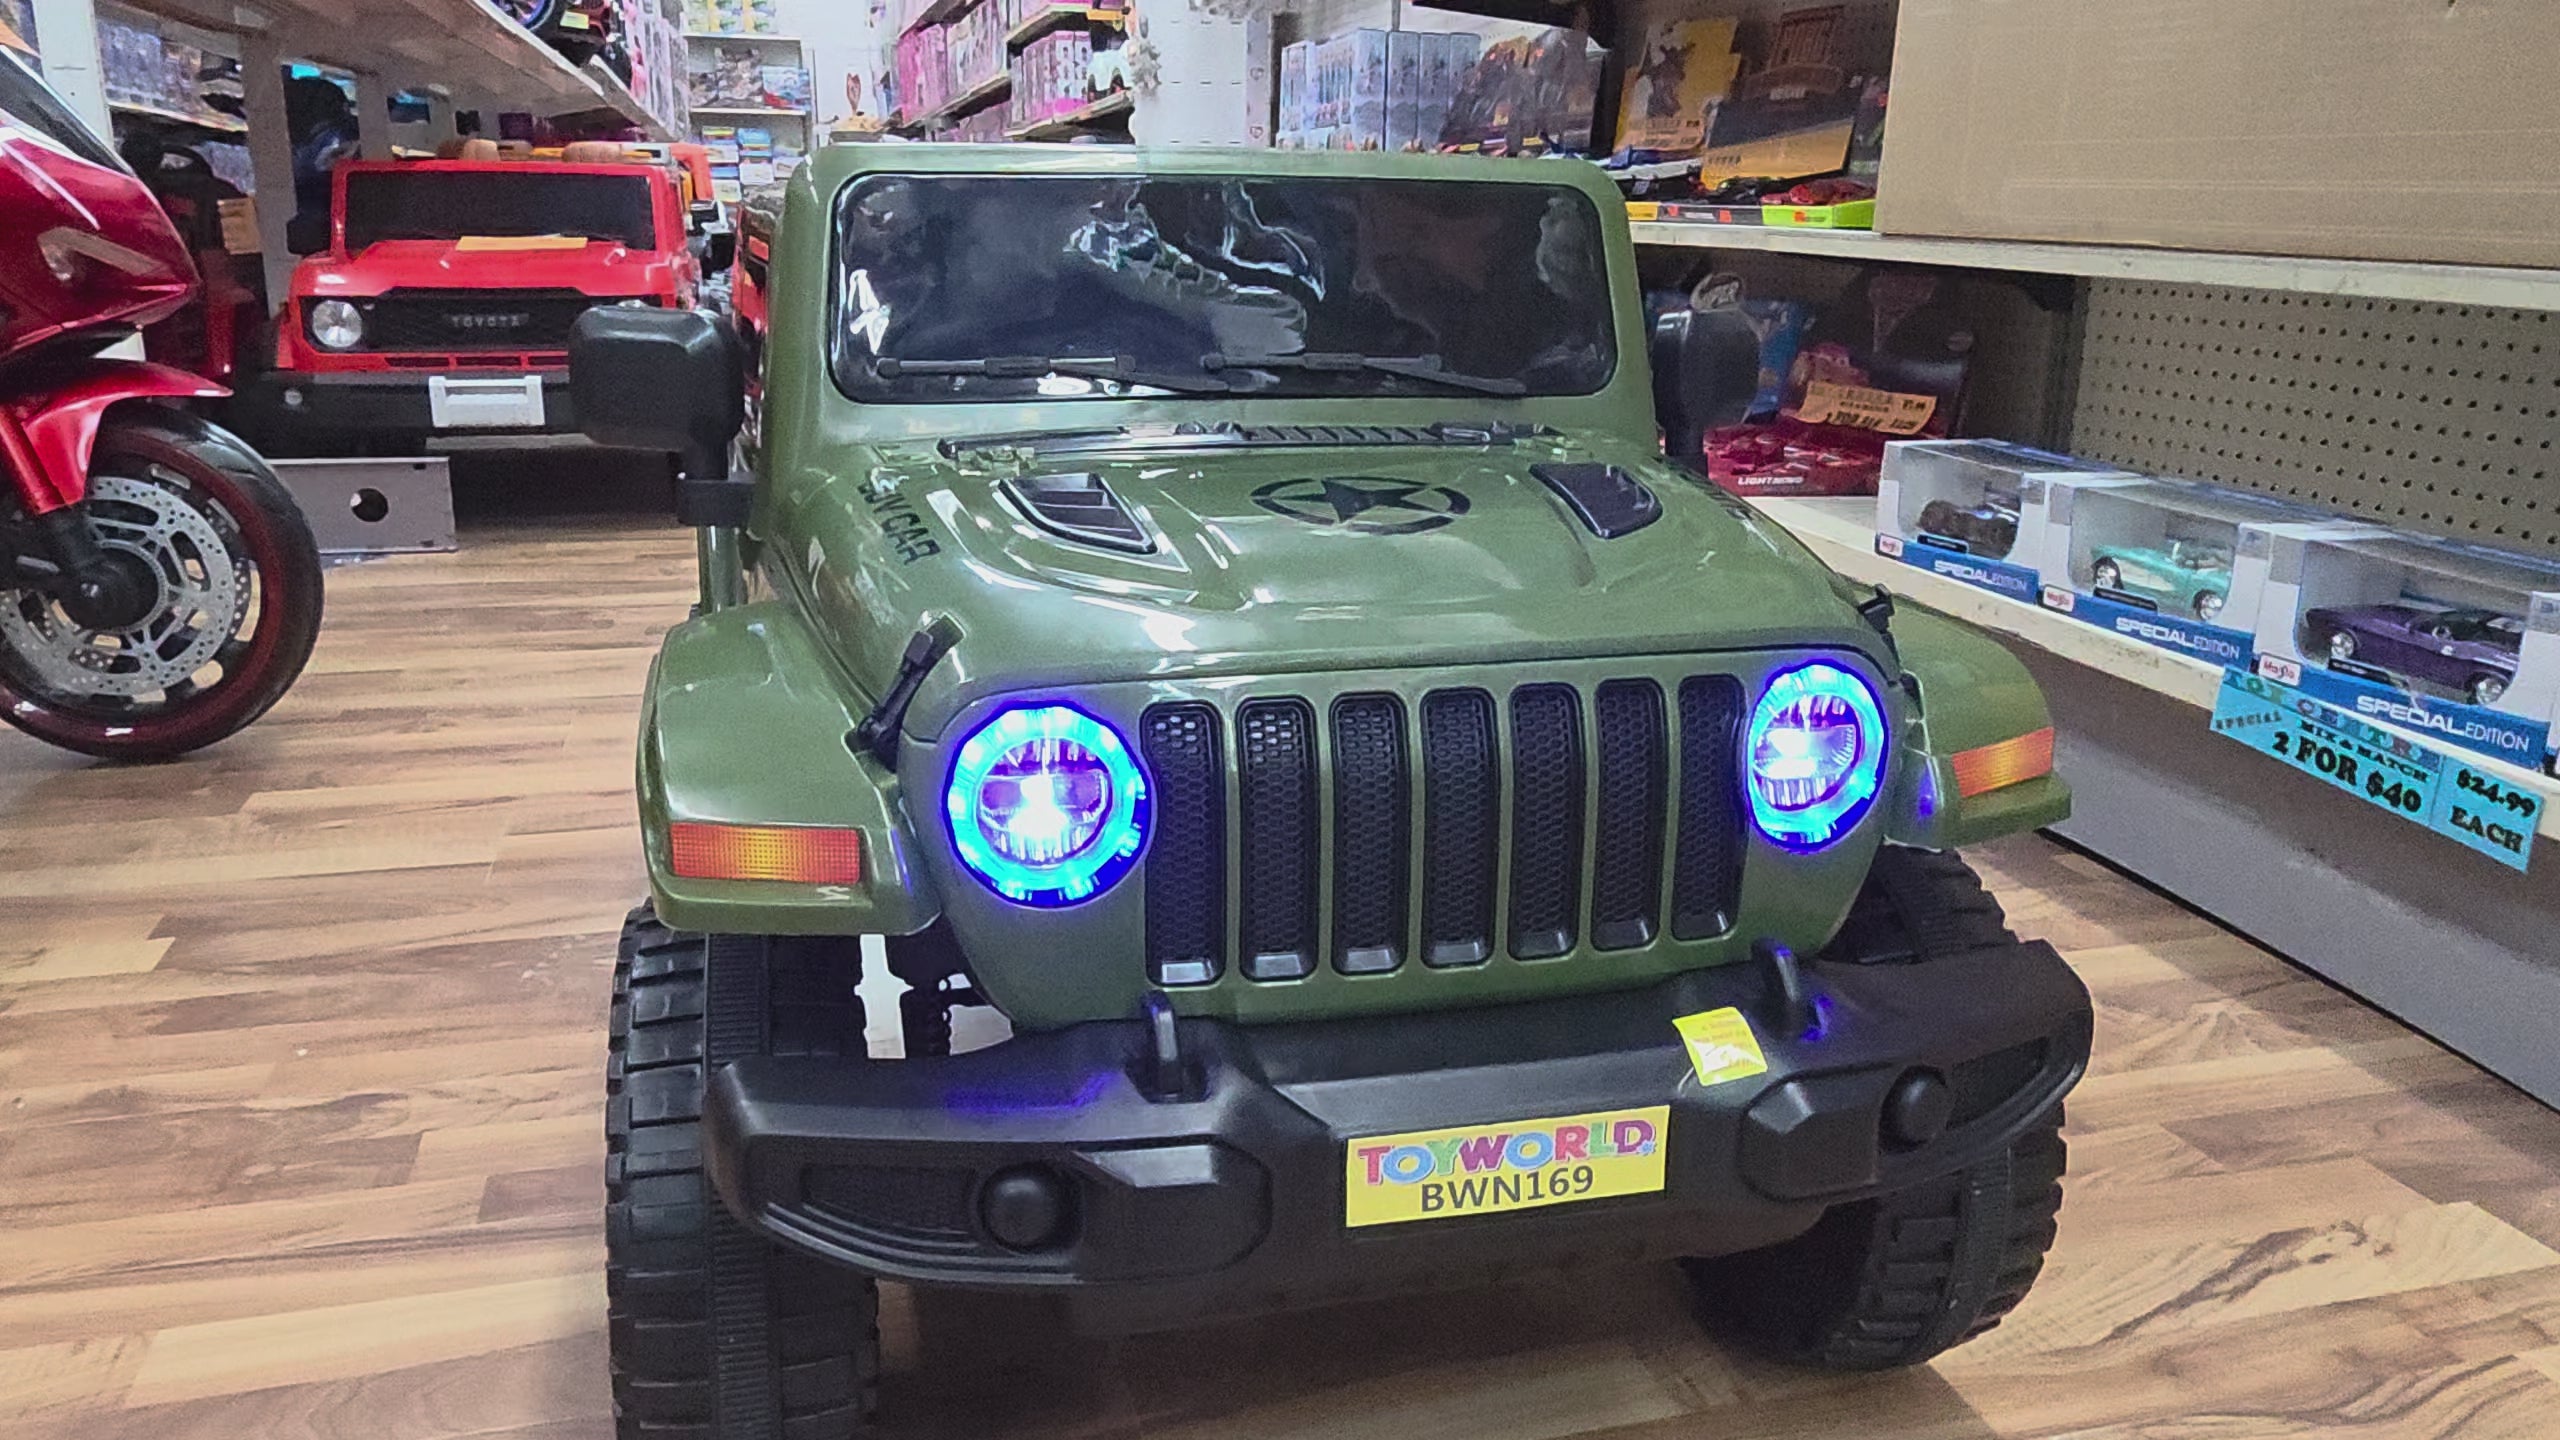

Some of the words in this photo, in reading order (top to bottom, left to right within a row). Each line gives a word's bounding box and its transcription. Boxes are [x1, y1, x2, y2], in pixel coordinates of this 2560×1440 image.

[452, 315, 520, 328] TOYOTA
[1934, 560, 1994, 585] SPECIAL
[2115, 616, 2194, 648] SPECIAL
[2193, 635, 2240, 660] EDITION
[2215, 711, 2282, 730] SPECIAL
[2356, 695, 2466, 737] SPECIAL
[2464, 721, 2530, 752] EDITION
[2271, 731, 2290, 755] 2
[2295, 734, 2358, 786] FOR
[2365, 770, 2422, 813] $40
[2300, 719, 2336, 744] MIX
[2357, 745, 2428, 783] MATCH
[2456, 768, 2536, 818] $24.99
[2449, 805, 2525, 854] EACH
[1358, 1119, 1656, 1185] TOYWORLD
[1421, 1165, 1594, 1212] BWN169
